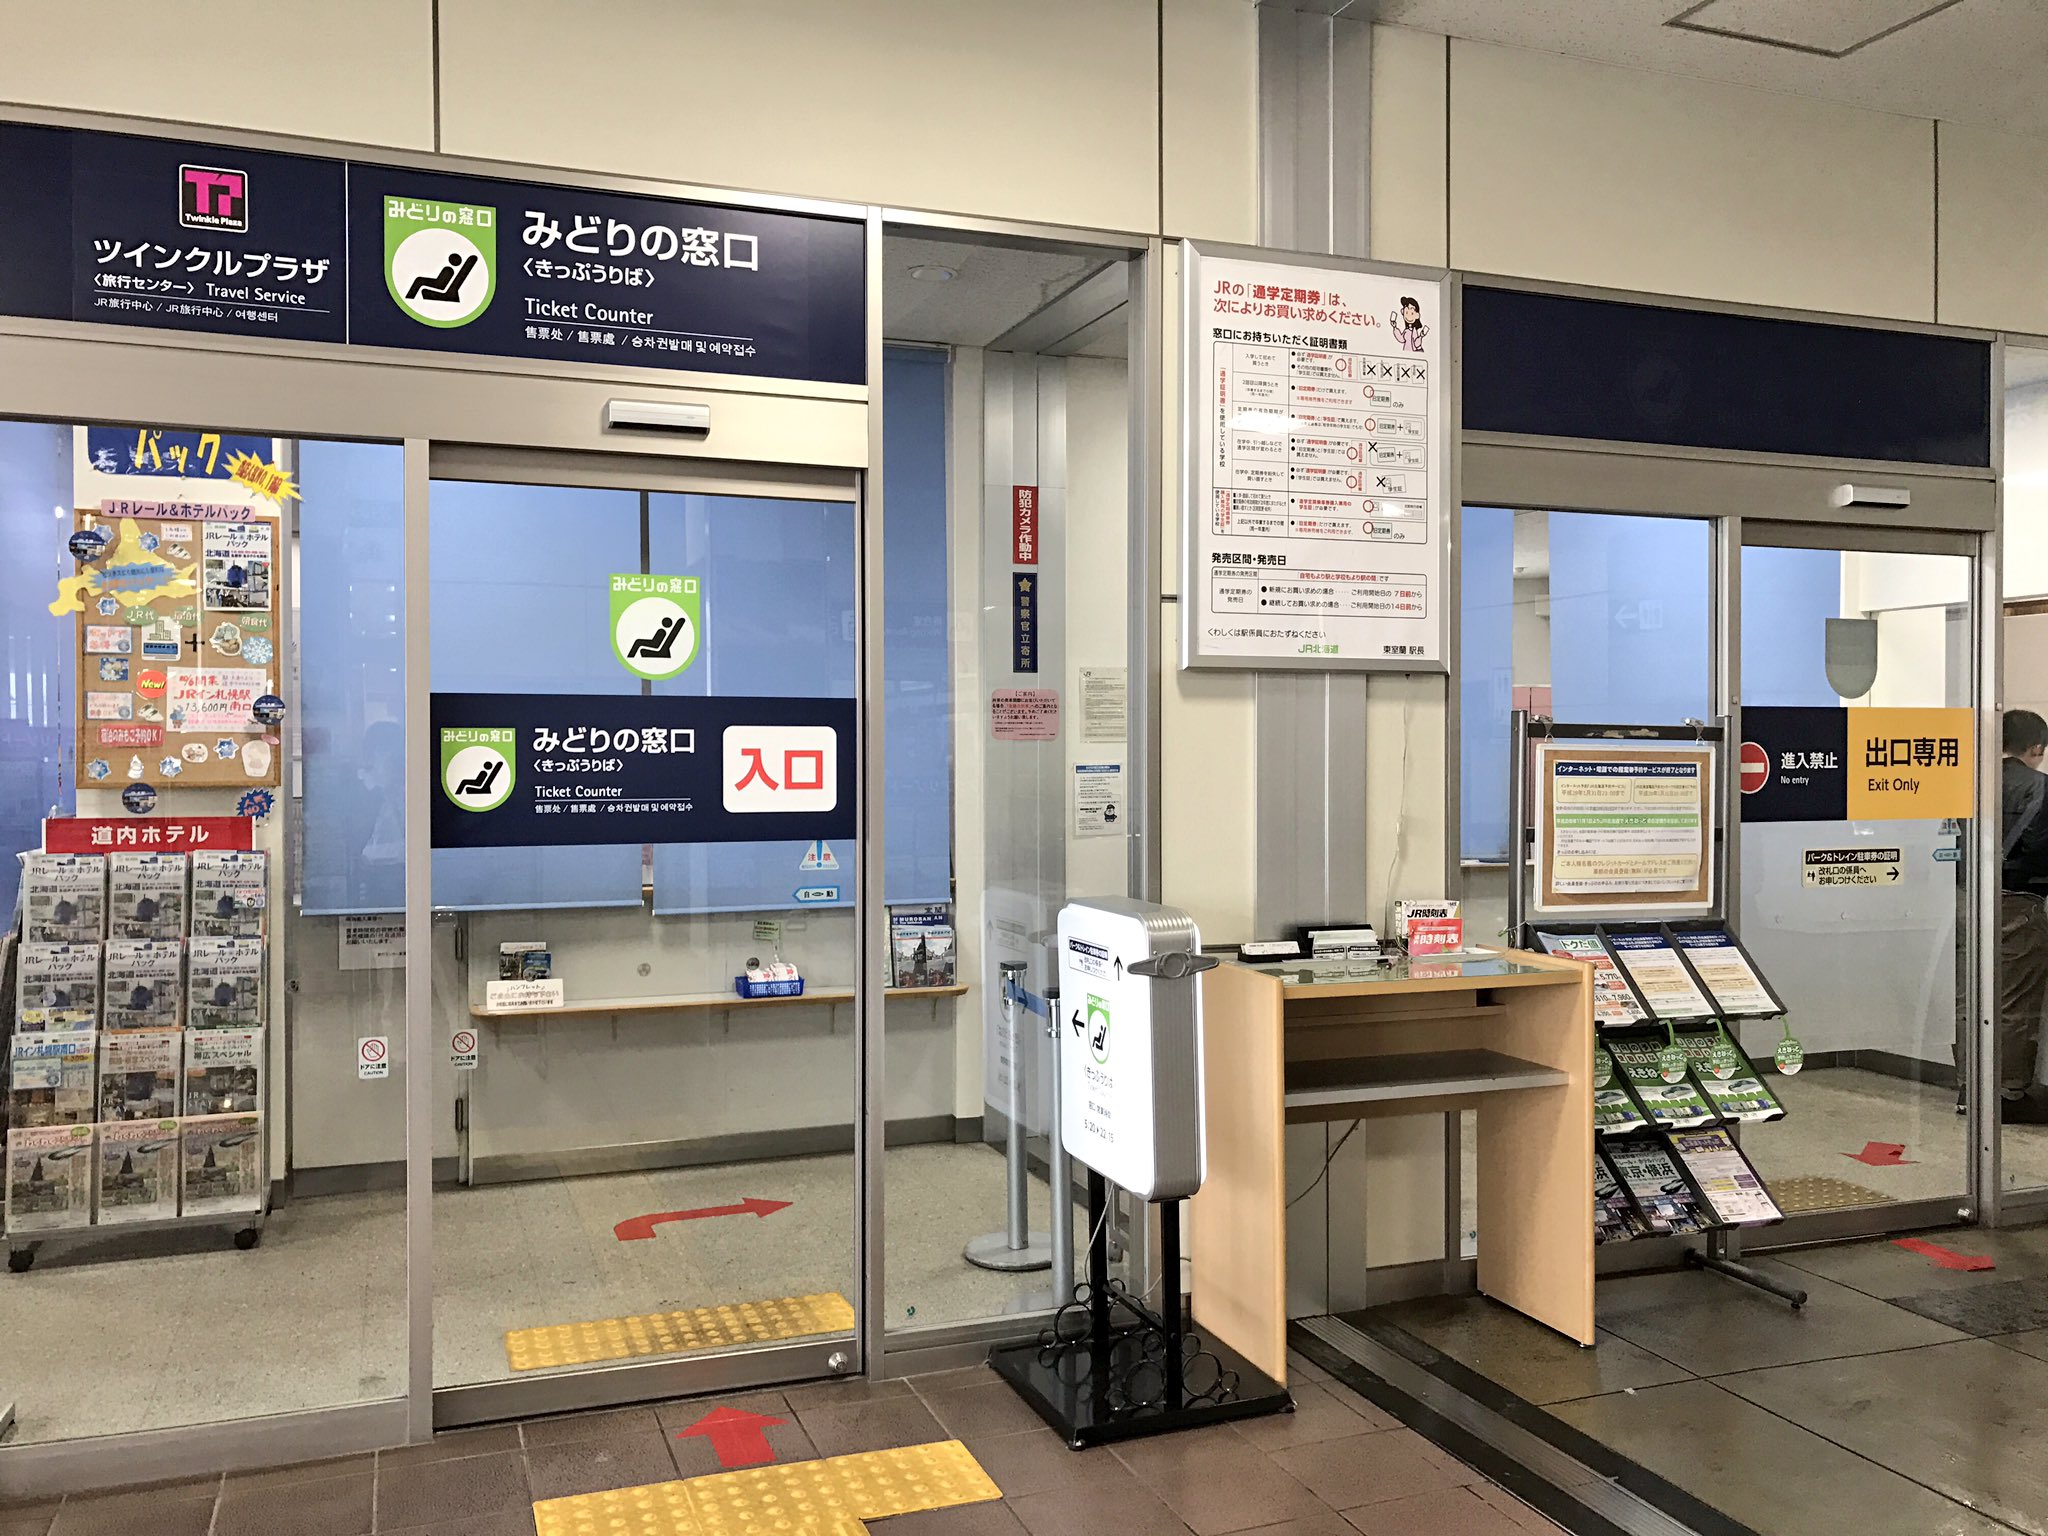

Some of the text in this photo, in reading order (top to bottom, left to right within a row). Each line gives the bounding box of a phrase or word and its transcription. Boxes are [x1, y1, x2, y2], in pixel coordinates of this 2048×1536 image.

[185, 212, 243, 228] Twinkle Plaza
[388, 199, 492, 228] みどりの窓口
[522, 210, 759, 271] みどりの窓口
[93, 239, 330, 285] ツインクルプラザ
[205, 282, 250, 301] Travel
[254, 287, 306, 306] Service
[1214, 280, 1347, 308] JRの「通学定期券」は、
[524, 297, 654, 326] Ticket Counter
[1213, 299, 1382, 328] 次によりお買い求めください。
[525, 325, 564, 342] 售票处
[1213, 328, 1347, 350] 窓口にお持ちいただく証明書類
[1018, 489, 1032, 561] 防犯カメラ作動中
[1211, 552, 1287, 566] 発売区間・発売日
[612, 577, 697, 594] みどりの窓口
[1020, 596, 1031, 668] 警察官立寄所
[443, 730, 514, 743] みどりの窓口
[533, 727, 695, 754] みどりの窓口
[1781, 751, 1839, 770] 進入禁止
[1865, 736, 1959, 768] 出口専用
[734, 748, 824, 792] 入口
[1780, 776, 1810, 786] No entry
[535, 785, 623, 798] Ticket Counter
[1868, 777, 1920, 795] Exit Only
[91, 825, 210, 846] 道内ホテル
